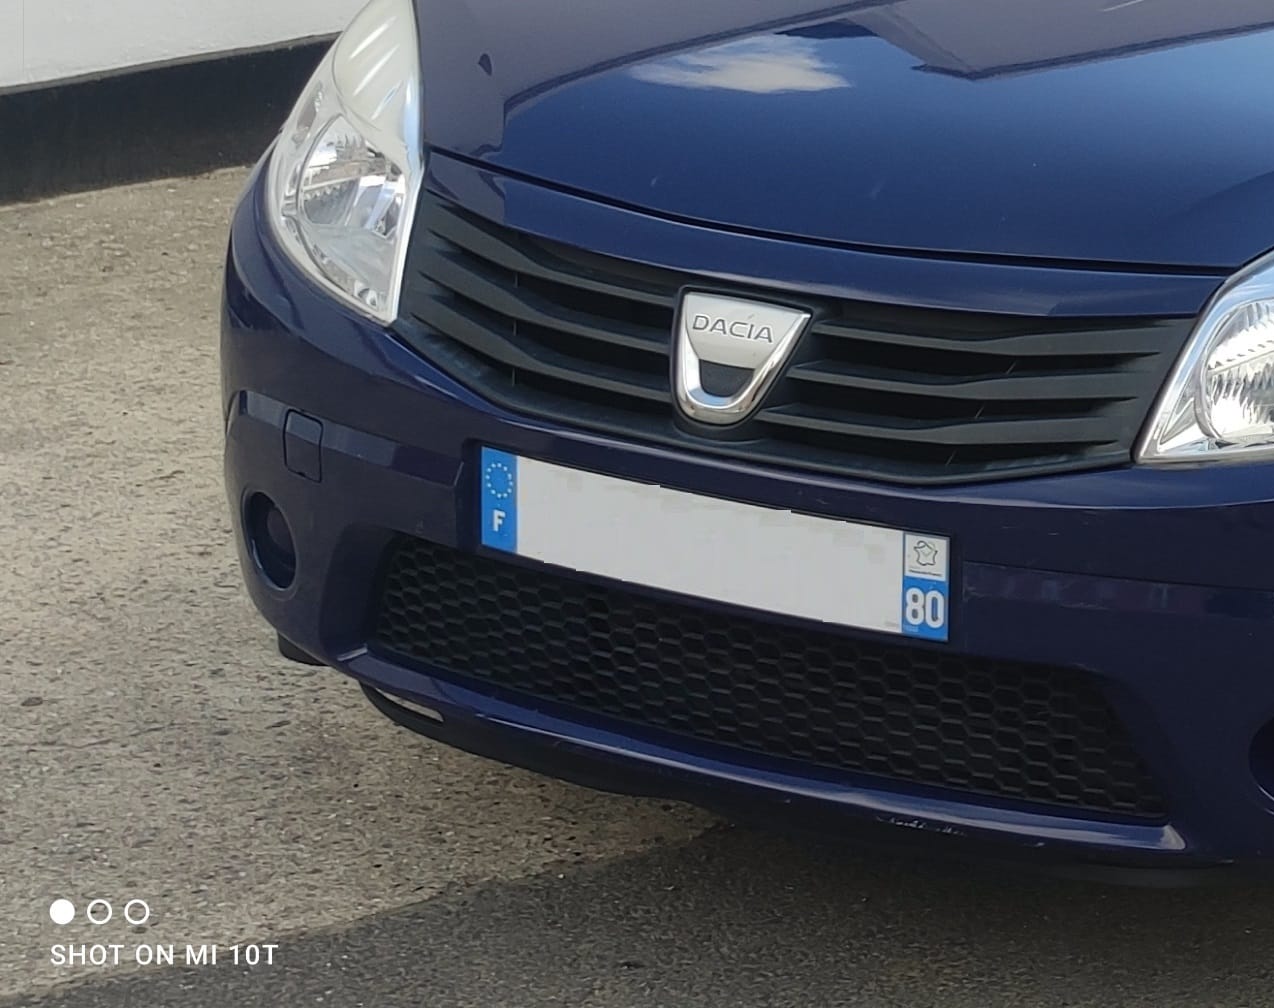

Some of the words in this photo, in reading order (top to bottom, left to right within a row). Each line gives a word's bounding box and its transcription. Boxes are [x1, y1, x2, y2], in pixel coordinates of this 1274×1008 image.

[692, 314, 774, 344] DACIA
[492, 508, 506, 532] F
[905, 587, 945, 628] 80
